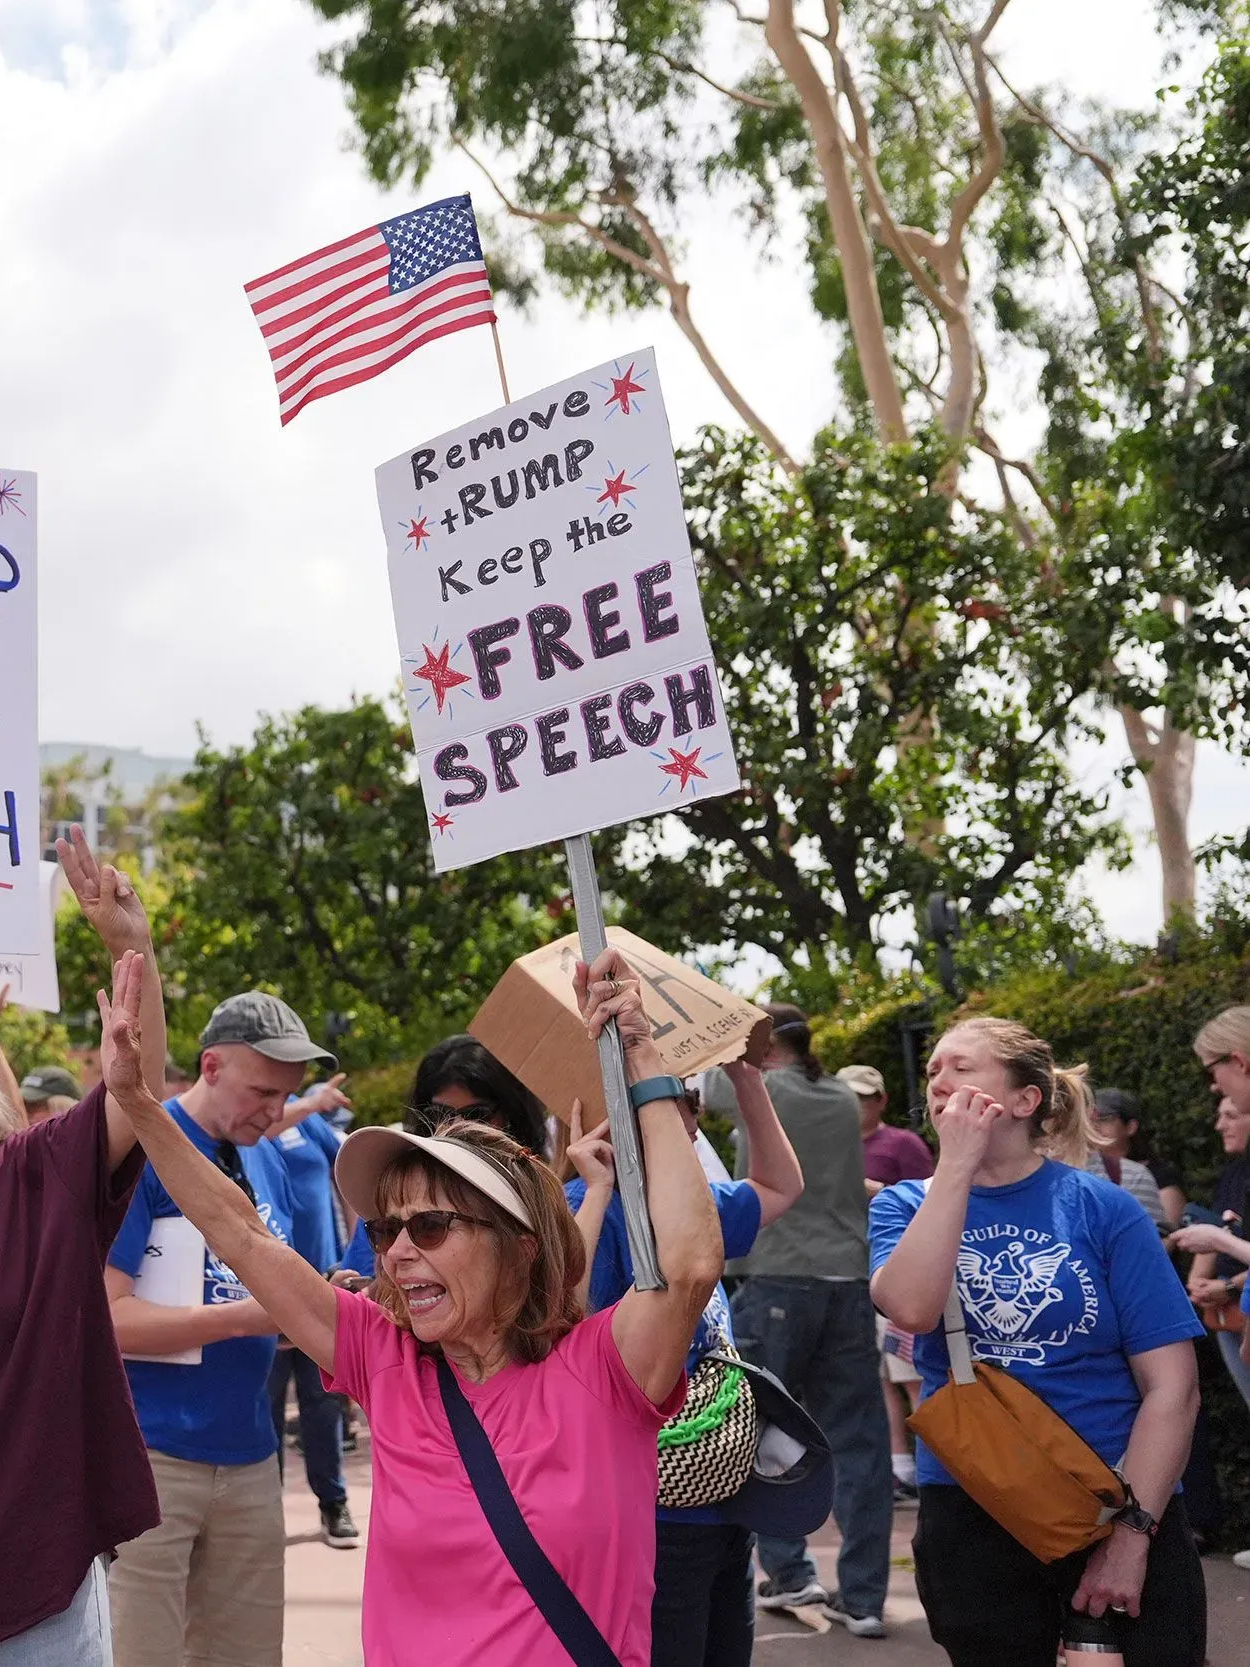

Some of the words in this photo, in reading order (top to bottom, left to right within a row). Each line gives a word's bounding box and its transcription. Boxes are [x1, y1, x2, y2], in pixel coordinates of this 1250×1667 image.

[410, 391, 590, 490] Remove
[441, 438, 595, 534] tRUMP
[437, 538, 553, 602] Keep
[565, 511, 633, 553] the
[467, 560, 680, 701] FREE
[433, 663, 717, 808] SPEECH
[671, 1037, 700, 1058] JUST
[694, 1032, 712, 1046] A
[705, 1012, 743, 1039] SCENE
[961, 1223, 1020, 1243] GUILD
[1024, 1228, 1053, 1245] OF
[1067, 1259, 1099, 1335] AMERICA
[991, 1345, 1026, 1357] WEST
